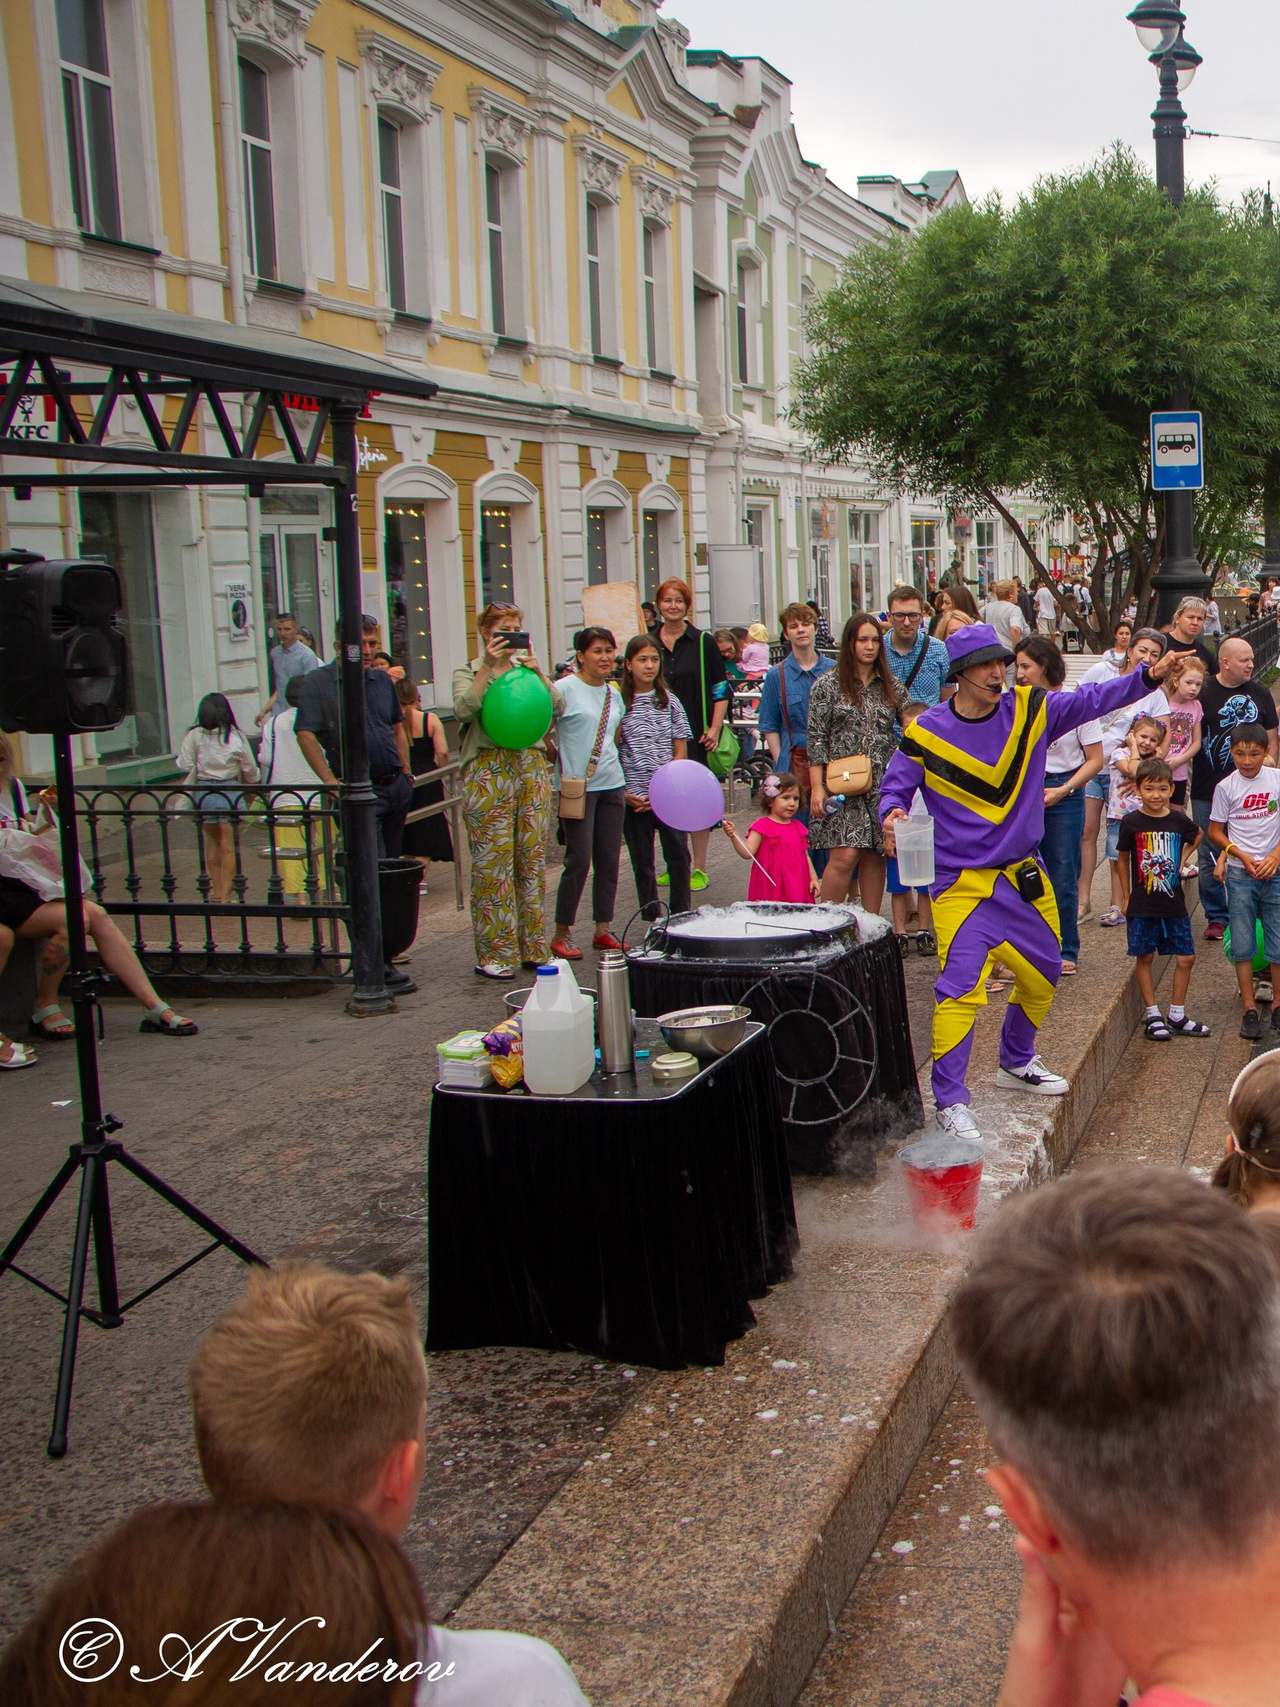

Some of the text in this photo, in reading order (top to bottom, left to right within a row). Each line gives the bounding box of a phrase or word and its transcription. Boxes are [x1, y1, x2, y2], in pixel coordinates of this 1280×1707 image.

[8, 425, 49, 440] KFC
[1243, 792, 1270, 809] ON
[1252, 808, 1278, 819] STREN
